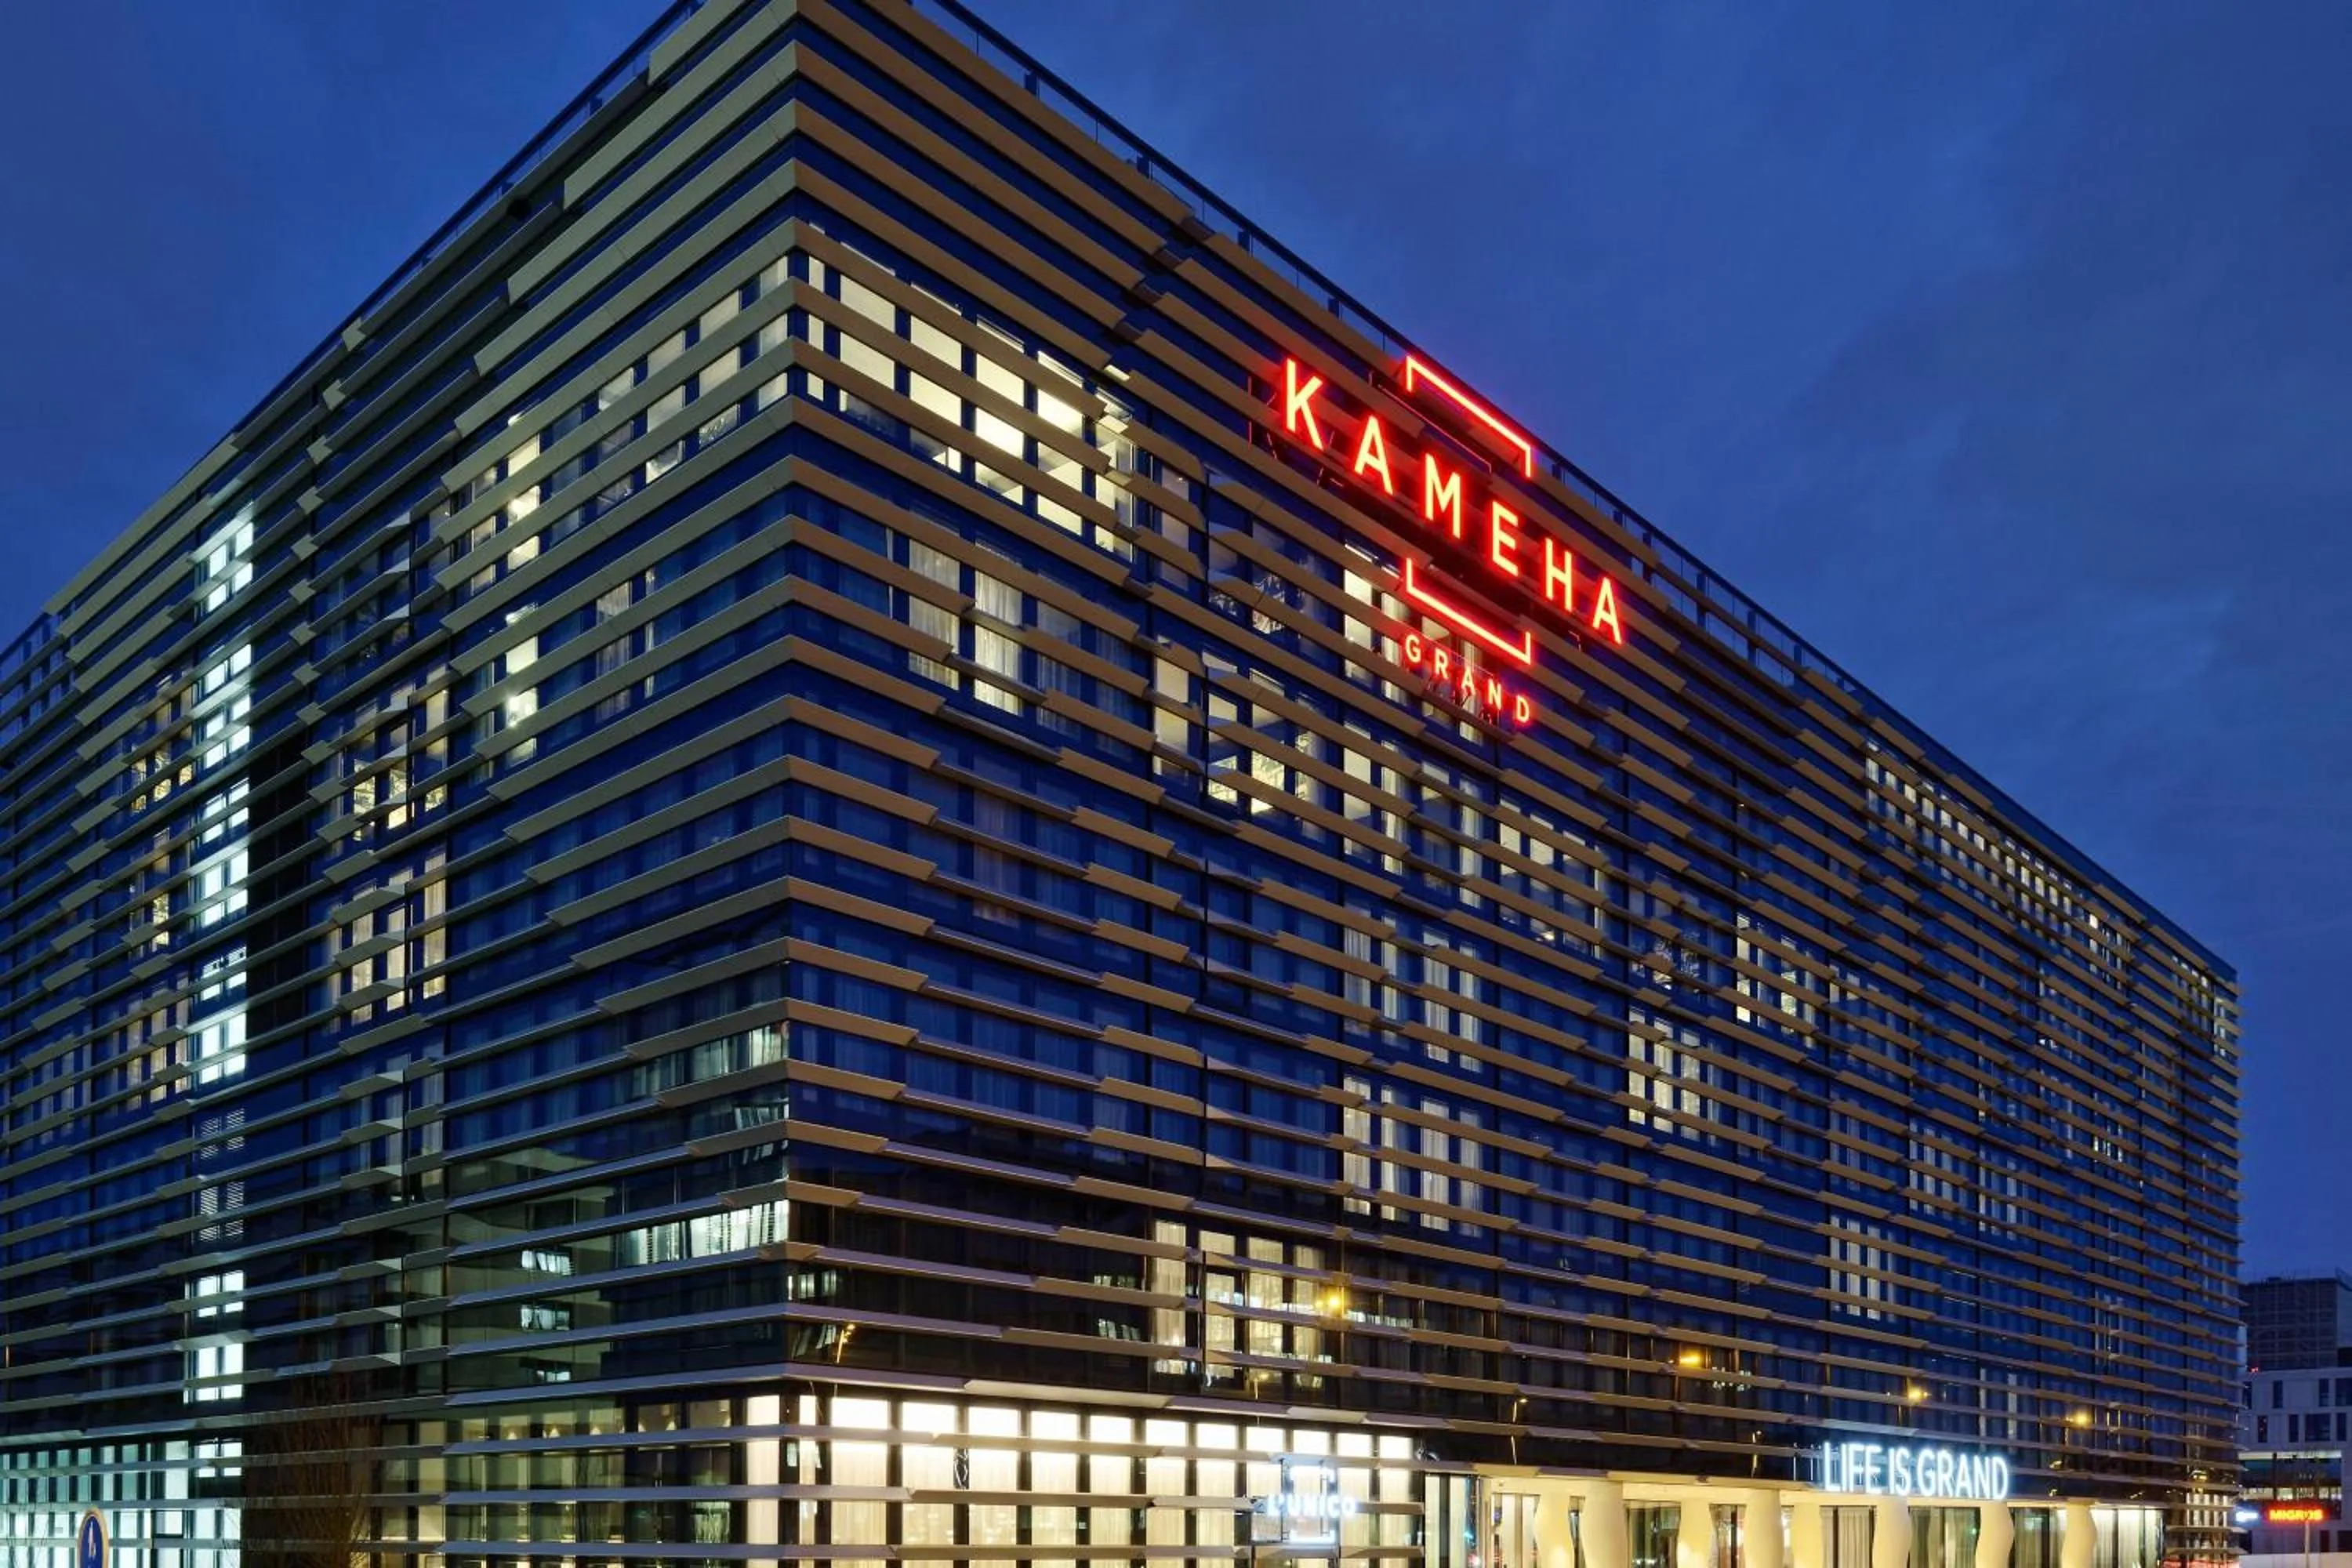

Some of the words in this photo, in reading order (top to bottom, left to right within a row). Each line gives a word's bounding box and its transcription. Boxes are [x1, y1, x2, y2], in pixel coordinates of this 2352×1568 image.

[1285, 357, 1623, 645] KAMEHA
[1404, 633, 1531, 724] GRAND
[1824, 1441, 1882, 1494] LIFE
[1888, 1446, 1911, 1496] IS
[1916, 1448, 2009, 1501] GRAND
